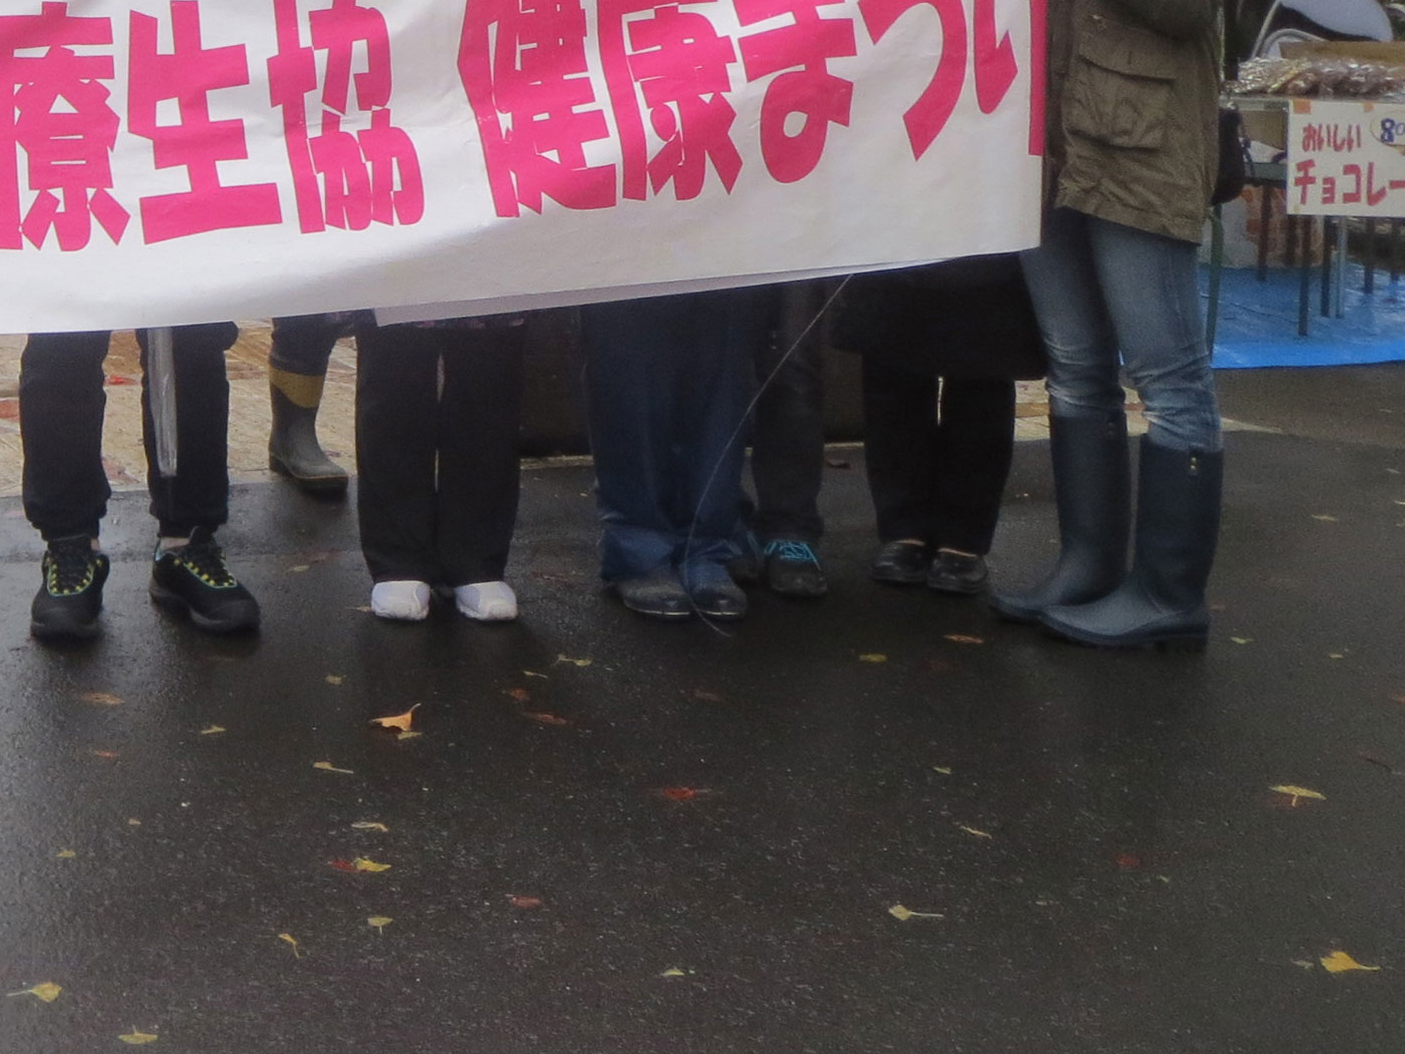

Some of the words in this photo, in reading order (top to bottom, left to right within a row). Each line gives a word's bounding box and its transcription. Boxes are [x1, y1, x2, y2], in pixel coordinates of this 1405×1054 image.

[1302, 124, 1361, 152] おいしい
[1294, 159, 1405, 206] チョコレー
